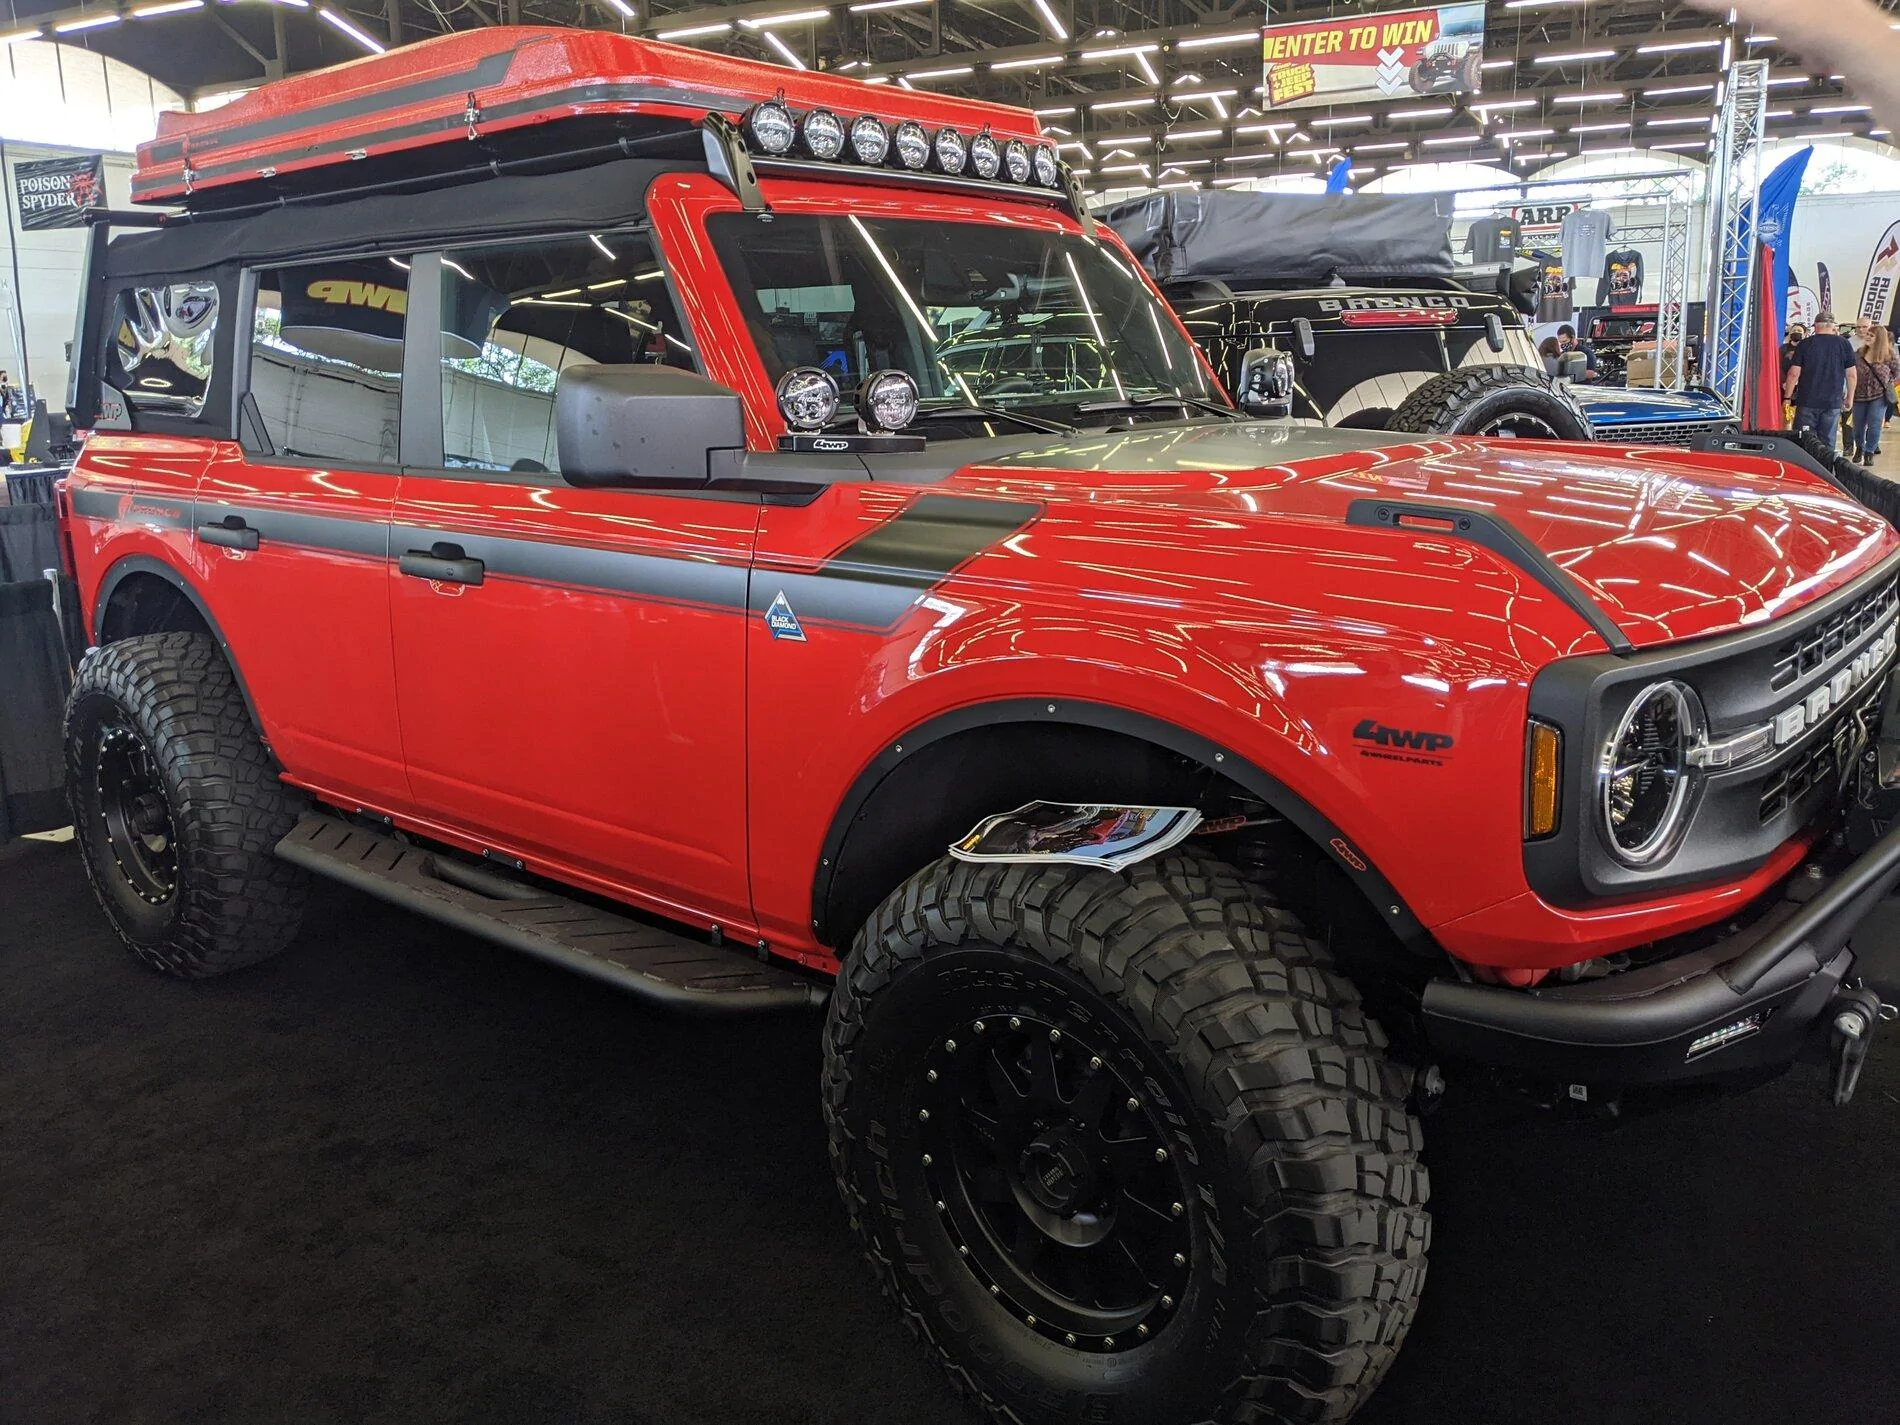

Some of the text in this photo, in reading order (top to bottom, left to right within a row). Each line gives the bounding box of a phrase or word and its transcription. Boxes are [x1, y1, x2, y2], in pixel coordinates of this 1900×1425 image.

[1272, 19, 1433, 59] ENTER TO WIN
[1271, 63, 1311, 82] TRUCK
[1273, 79, 1314, 101] FEST
[20, 175, 71, 195] POISON
[22, 192, 78, 212] SPYDER
[1318, 296, 1470, 312] BRONCO
[771, 614, 789, 623] BLACK
[771, 620, 797, 630] DIAMOND
[1775, 624, 1897, 745] BRONCO
